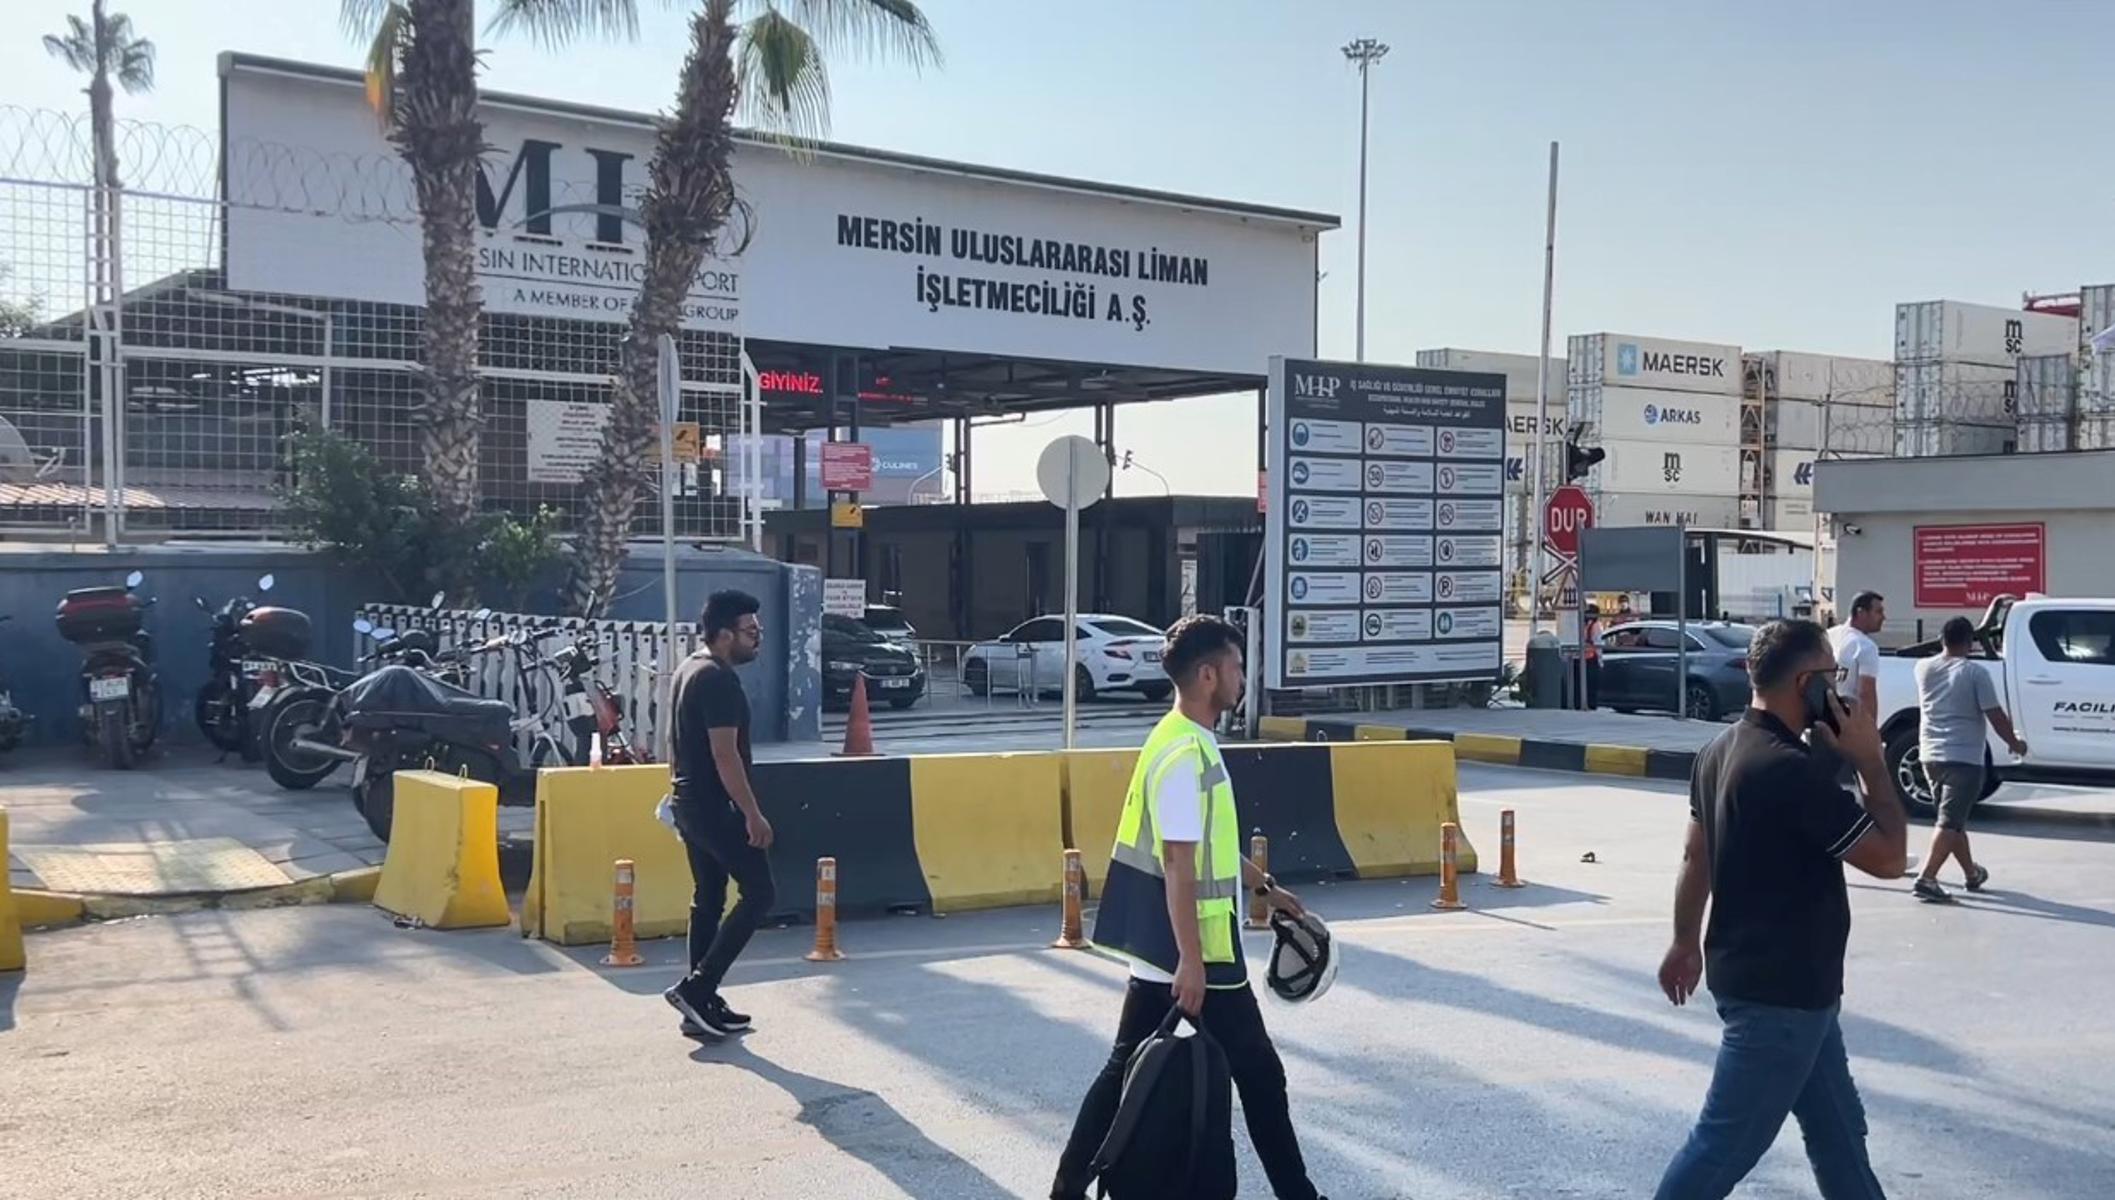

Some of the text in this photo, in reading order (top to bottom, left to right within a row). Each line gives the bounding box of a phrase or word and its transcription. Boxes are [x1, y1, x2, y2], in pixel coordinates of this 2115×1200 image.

[837, 214, 1208, 286] MERSİN ULUSLARARASI LİMAN
[522, 254, 646, 283] INTERNATIO
[514, 289, 739, 321] A MEMBER OF GROUP
[916, 265, 1151, 331] İŞLETMECİLİĞİ A.Ş.
[1643, 352, 1724, 377] MAERSK
[1661, 408, 1701, 424] ARKAS
[1646, 511, 1670, 524] WAN
